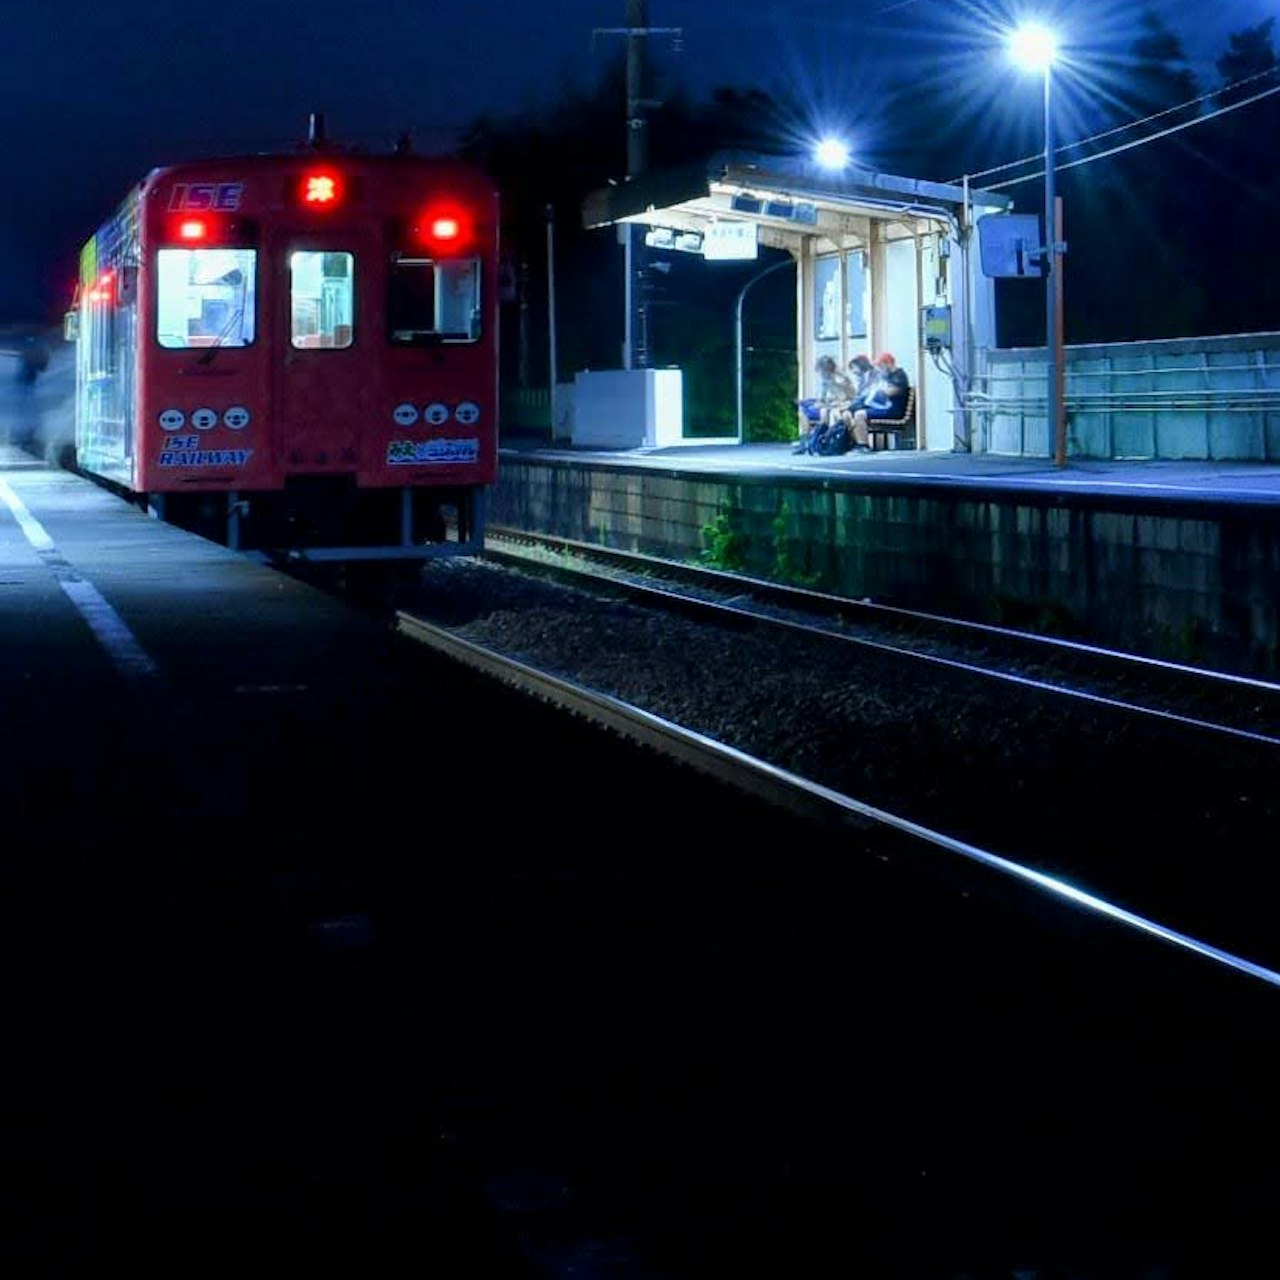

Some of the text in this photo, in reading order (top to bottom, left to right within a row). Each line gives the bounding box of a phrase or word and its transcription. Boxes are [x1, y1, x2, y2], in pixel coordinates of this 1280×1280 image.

[168, 181, 243, 212] ISE
[162, 434, 199, 450] ISE
[158, 449, 253, 467] RAILWAY
